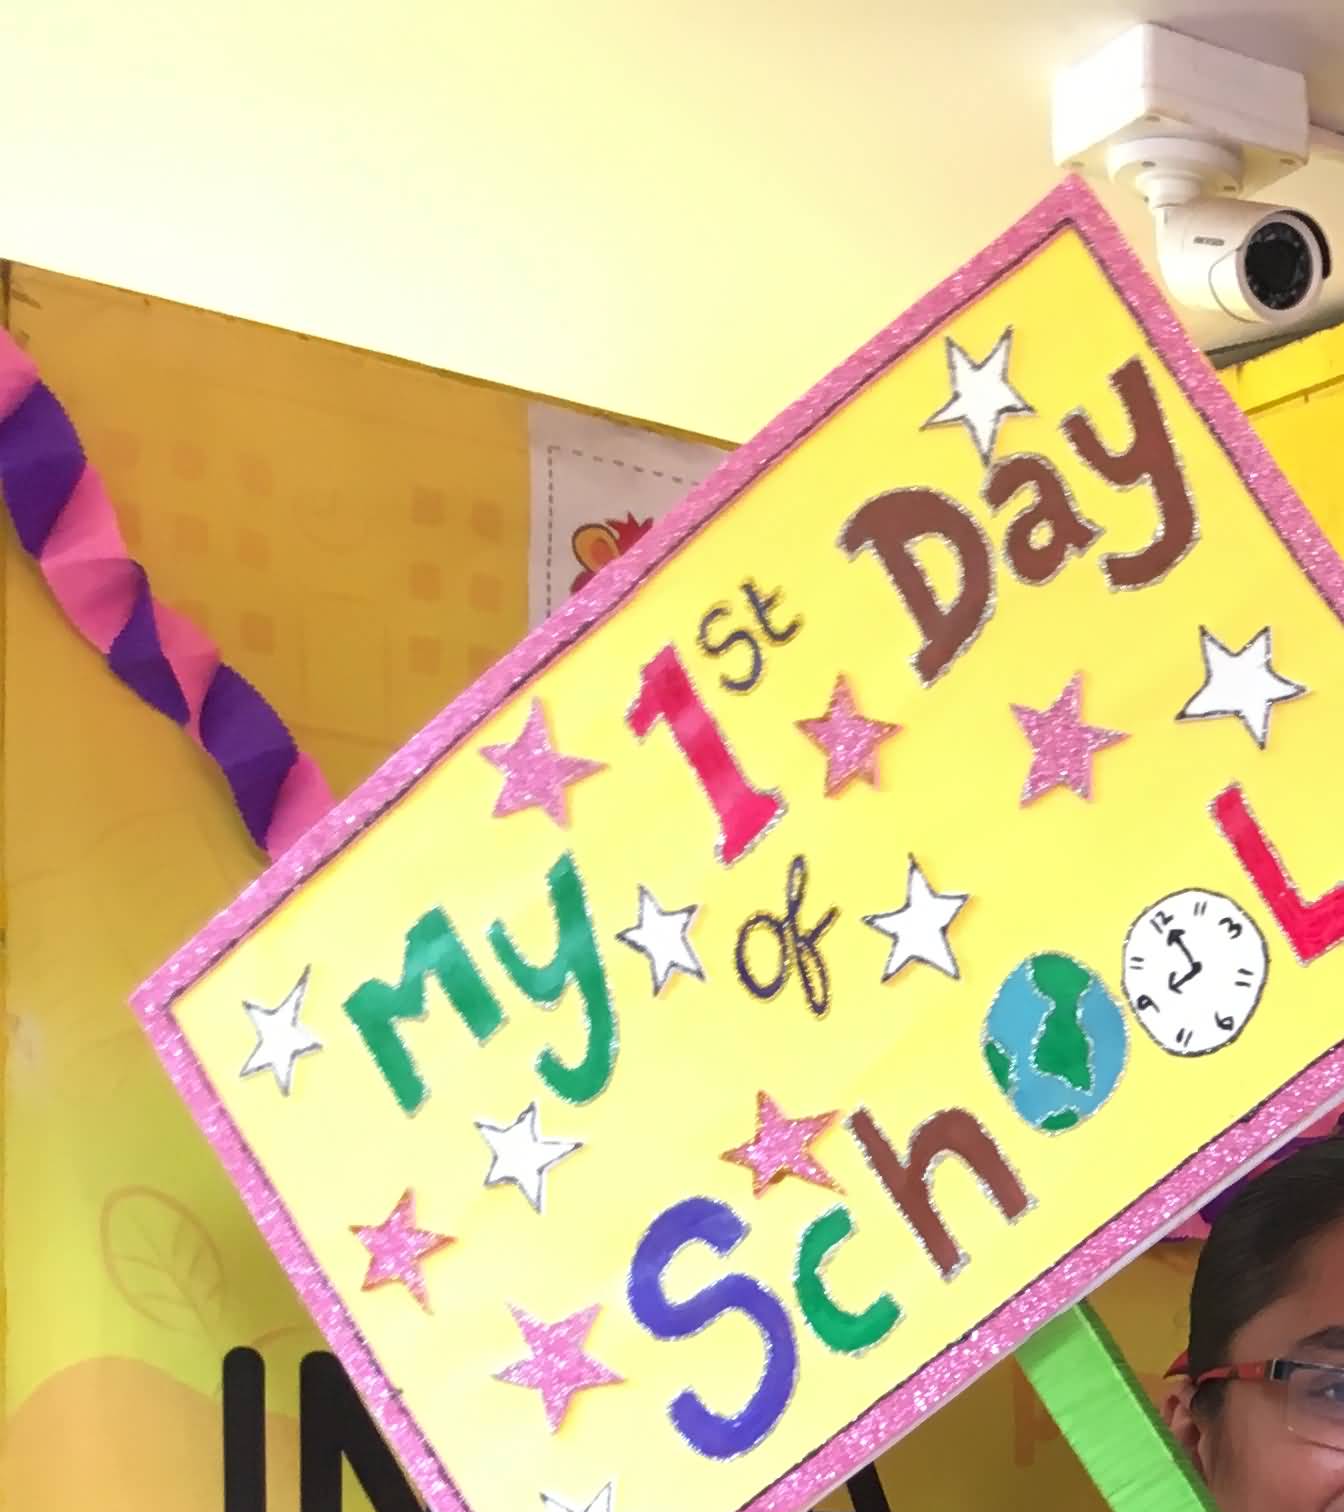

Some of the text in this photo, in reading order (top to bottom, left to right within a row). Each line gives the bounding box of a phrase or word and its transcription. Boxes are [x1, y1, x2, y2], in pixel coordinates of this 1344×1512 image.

[343, 850, 620, 1115] My
[837, 355, 1200, 688] Day
[734, 855, 841, 1019] of
